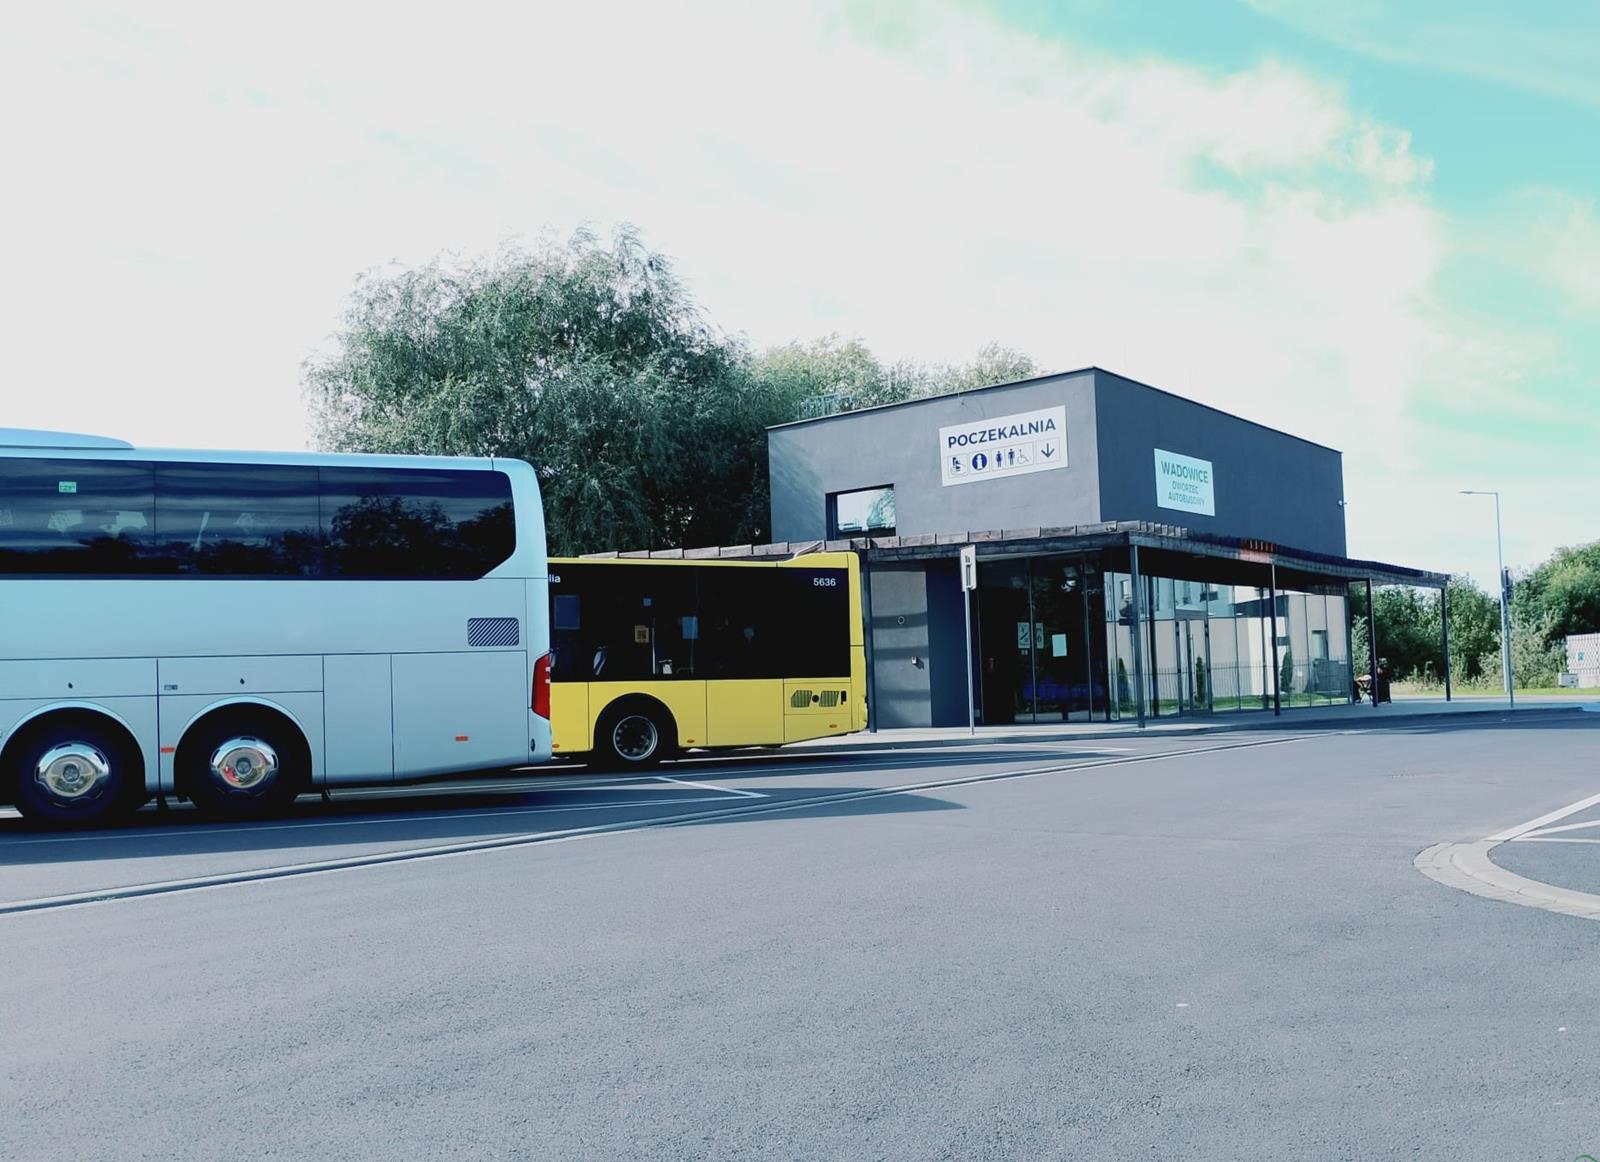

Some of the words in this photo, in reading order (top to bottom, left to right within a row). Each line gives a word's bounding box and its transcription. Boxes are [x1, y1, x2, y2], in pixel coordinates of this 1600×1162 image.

[948, 418, 1056, 448] POCZEKALNIA
[1161, 461, 1209, 484] WADOWICE
[813, 577, 837, 587] 5636
